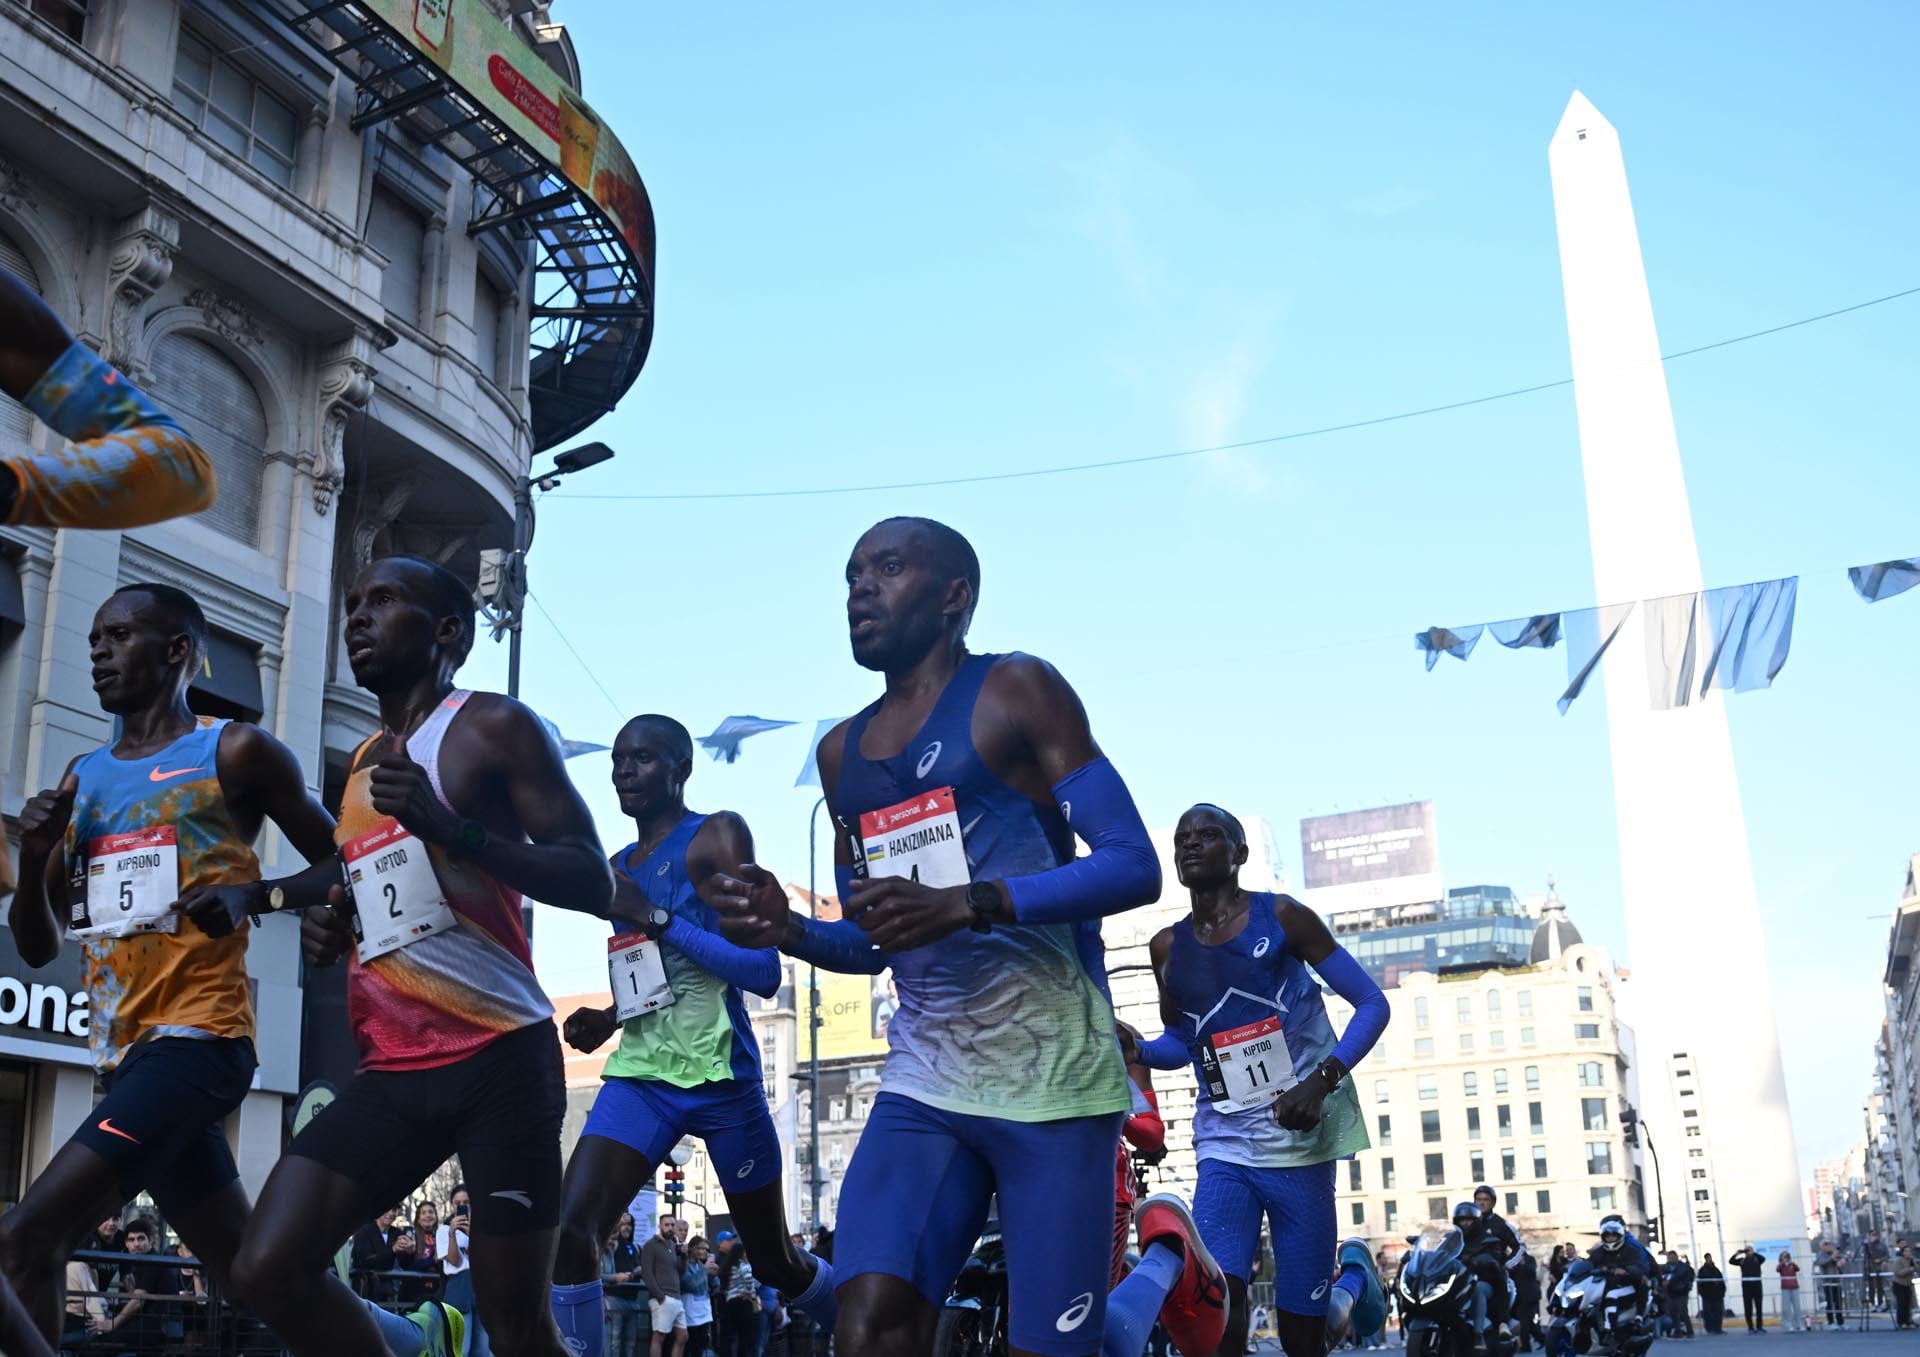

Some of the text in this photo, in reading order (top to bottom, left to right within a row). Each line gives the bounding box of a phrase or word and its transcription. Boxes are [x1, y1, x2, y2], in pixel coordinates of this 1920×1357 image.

[890, 804, 921, 824] personal
[112, 836, 145, 848] personal
[362, 830, 389, 849] personal
[850, 834, 862, 861] A
[888, 823, 955, 858] HAKIZIMANA
[117, 854, 161, 872] KIPRONO
[374, 849, 408, 875] KIPTOO
[120, 880, 133, 911] 5
[383, 883, 403, 918] 2
[624, 949, 644, 965] KIBET
[629, 971, 638, 995] 1
[834, 1001, 861, 1016] OFF
[1232, 1028, 1258, 1040] personal
[1202, 1046, 1212, 1062] A
[1242, 1040, 1272, 1057] KIPTOO
[1245, 1060, 1270, 1087] 11
